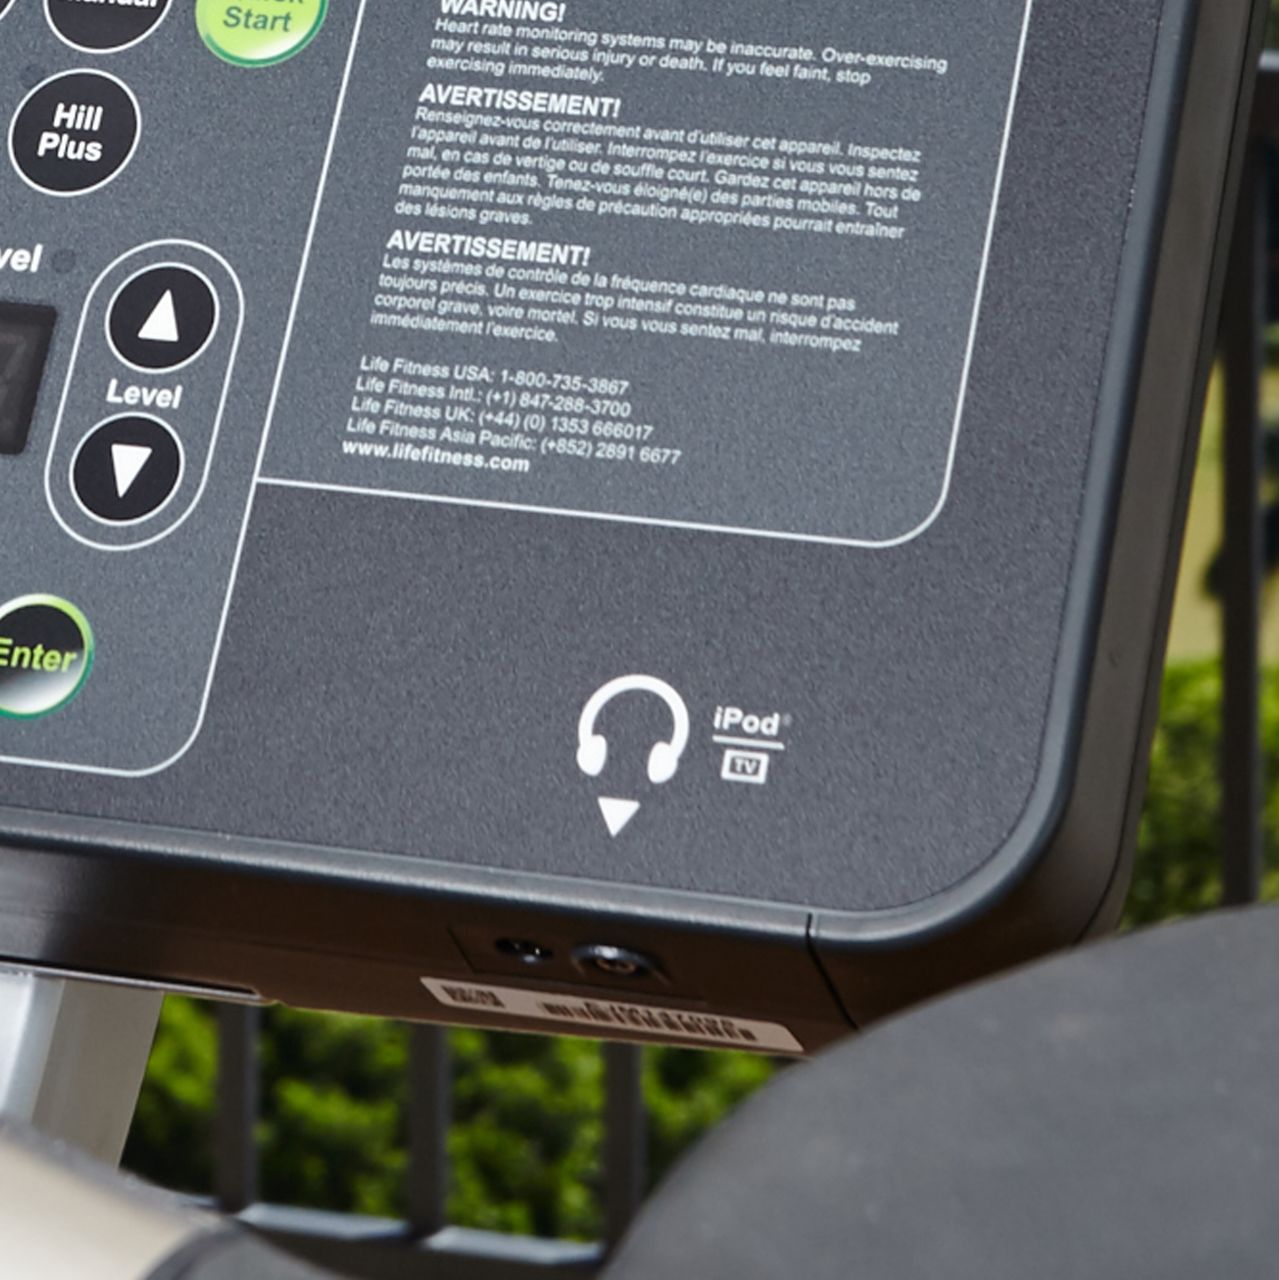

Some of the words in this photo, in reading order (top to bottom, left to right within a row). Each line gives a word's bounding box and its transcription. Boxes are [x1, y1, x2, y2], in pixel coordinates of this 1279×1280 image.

[222, 6, 294, 35] Start
[434, 17, 479, 34] Heart
[481, 22, 513, 37] rate
[515, 25, 598, 46] monitoring
[600, 32, 665, 49] systems
[668, 37, 703, 54] may
[705, 38, 727, 54] be
[729, 41, 816, 61] inaccurate.
[821, 46, 948, 74] Over-exercising
[426, 55, 505, 76] exercising
[507, 60, 604, 84] immediately.
[417, 82, 621, 118] AVERTISSEMENT!
[53, 102, 103, 133] Hill
[37, 132, 103, 162] Plus
[394, 199, 421, 215] des
[478, 209, 532, 225] graves.
[398, 183, 495, 202] manquement
[495, 191, 524, 204] aux
[575, 195, 596, 211] de
[772, 215, 833, 232] pourrait
[385, 229, 591, 266] AVERTISSEMENT!
[359, 355, 389, 372] Life
[392, 357, 449, 378] Fitness
[453, 364, 495, 382] USA:
[501, 368, 629, 395] 1-800-735-3867
[105, 379, 182, 410] Level
[355, 375, 385, 393] Life
[387, 377, 445, 398] Fitness
[485, 389, 516, 408] (+1)
[518, 391, 631, 417] 847-288-3700
[350, 395, 381, 413] Life
[383, 398, 441, 419] Fitness
[444, 405, 474, 422] UK:
[478, 410, 520, 429] (+44)
[522, 413, 546, 432] (0)
[551, 415, 589, 434] 1353
[591, 419, 653, 440] 666017
[341, 440, 530, 472] www.lifefitness.com
[346, 416, 376, 434] Life
[378, 418, 436, 440] Fitness
[438, 425, 475, 444] Asia
[478, 428, 536, 450] Pacific:
[540, 437, 592, 458] (+852)
[594, 441, 635, 460] 2891
[639, 446, 681, 464] 6677
[734, 758, 757, 774] TV
